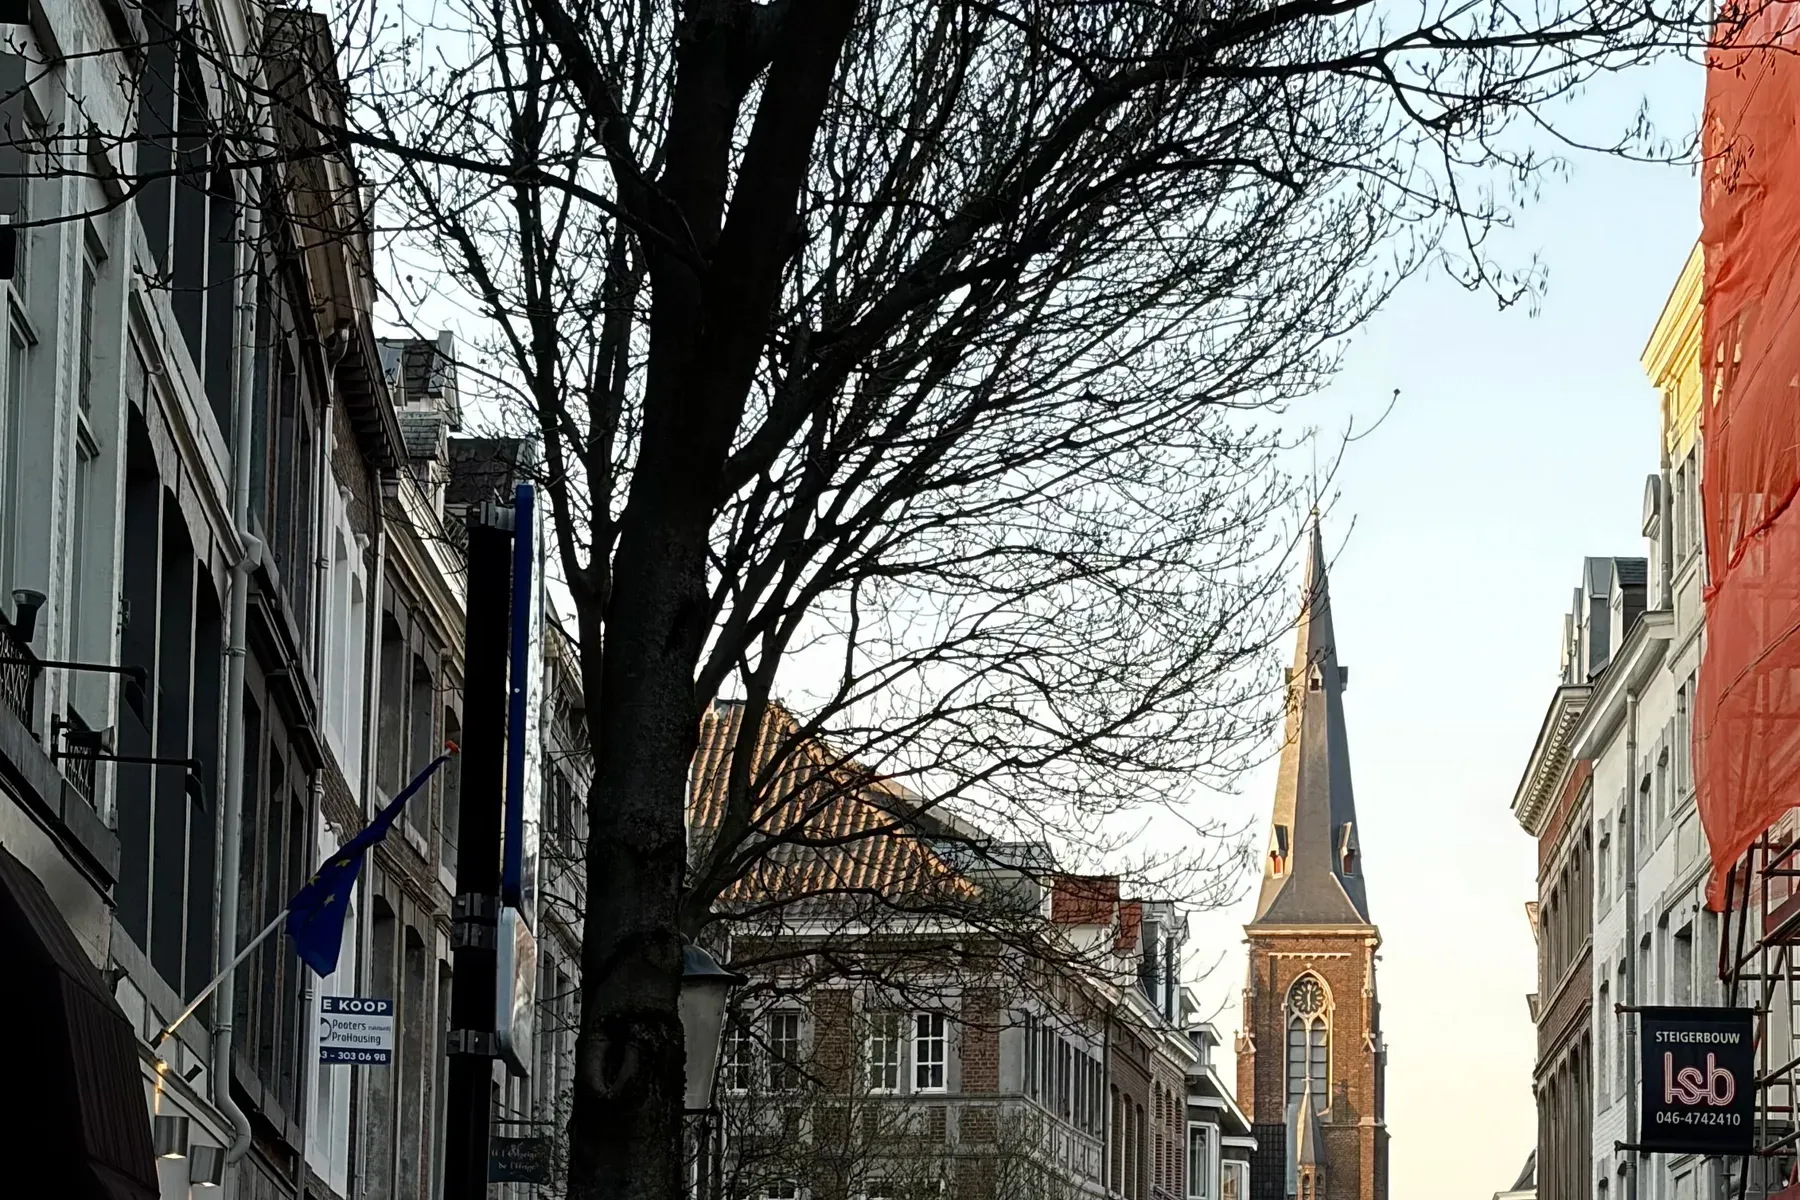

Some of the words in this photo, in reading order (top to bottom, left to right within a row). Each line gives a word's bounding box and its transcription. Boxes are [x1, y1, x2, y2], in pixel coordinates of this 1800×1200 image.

[323, 999, 332, 1010] E
[339, 1000, 387, 1012] KOOP
[332, 1019, 366, 1030] Pooters
[332, 1031, 381, 1046] ProHousing
[1655, 1031, 1741, 1044] STEIGERBOUW
[320, 1050, 328, 1059] 3
[338, 1051, 356, 1060] 303
[358, 1052, 371, 1062] 06
[373, 1053, 386, 1062] 98
[1656, 1111, 1741, 1126] 046-4742410
